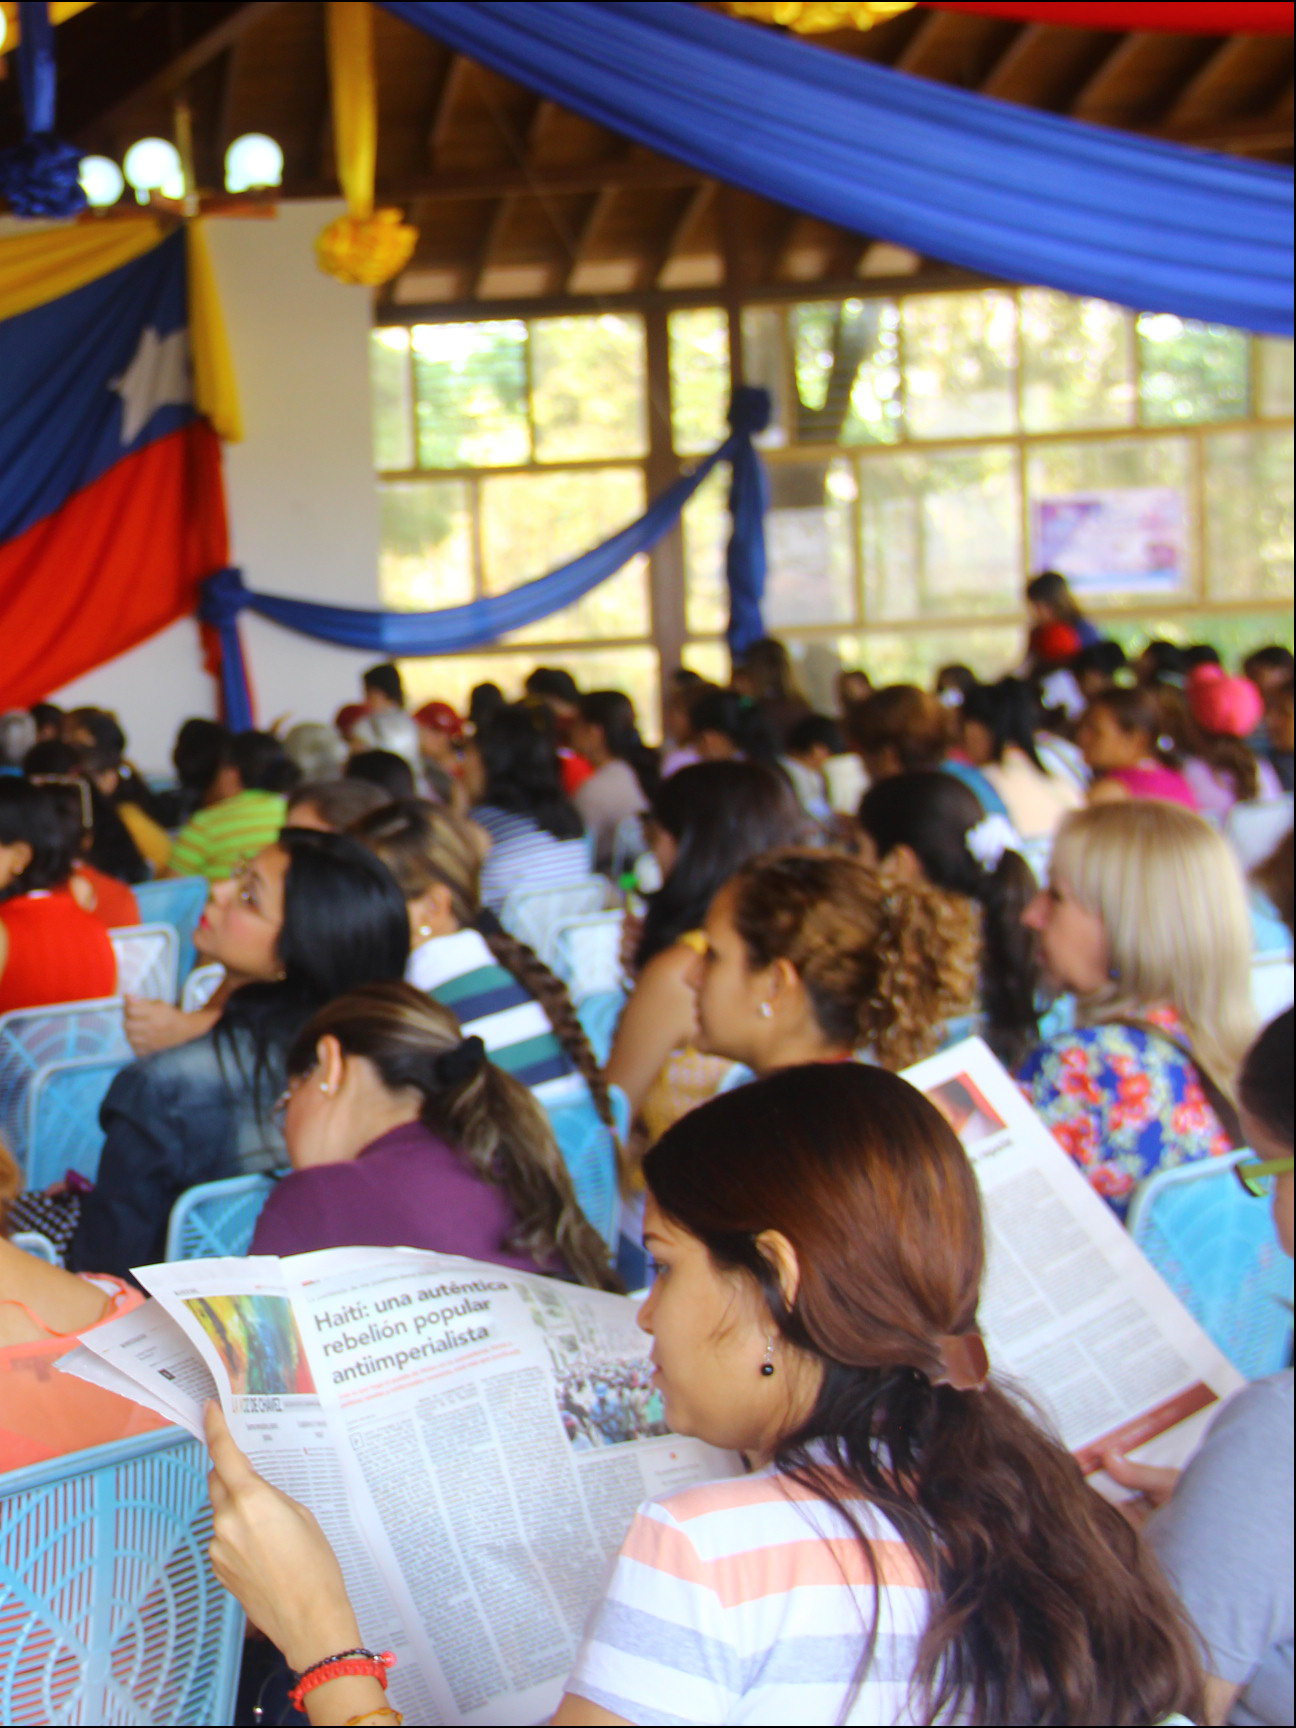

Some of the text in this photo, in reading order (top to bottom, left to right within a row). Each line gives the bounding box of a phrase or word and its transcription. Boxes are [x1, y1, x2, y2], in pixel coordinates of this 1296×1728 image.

[314, 1300, 371, 1332] Haití:
[374, 1292, 413, 1314] una
[417, 1279, 509, 1302] auténtica
[322, 1297, 491, 1357] rebelión popular
[332, 1326, 490, 1385] antiimperialista
